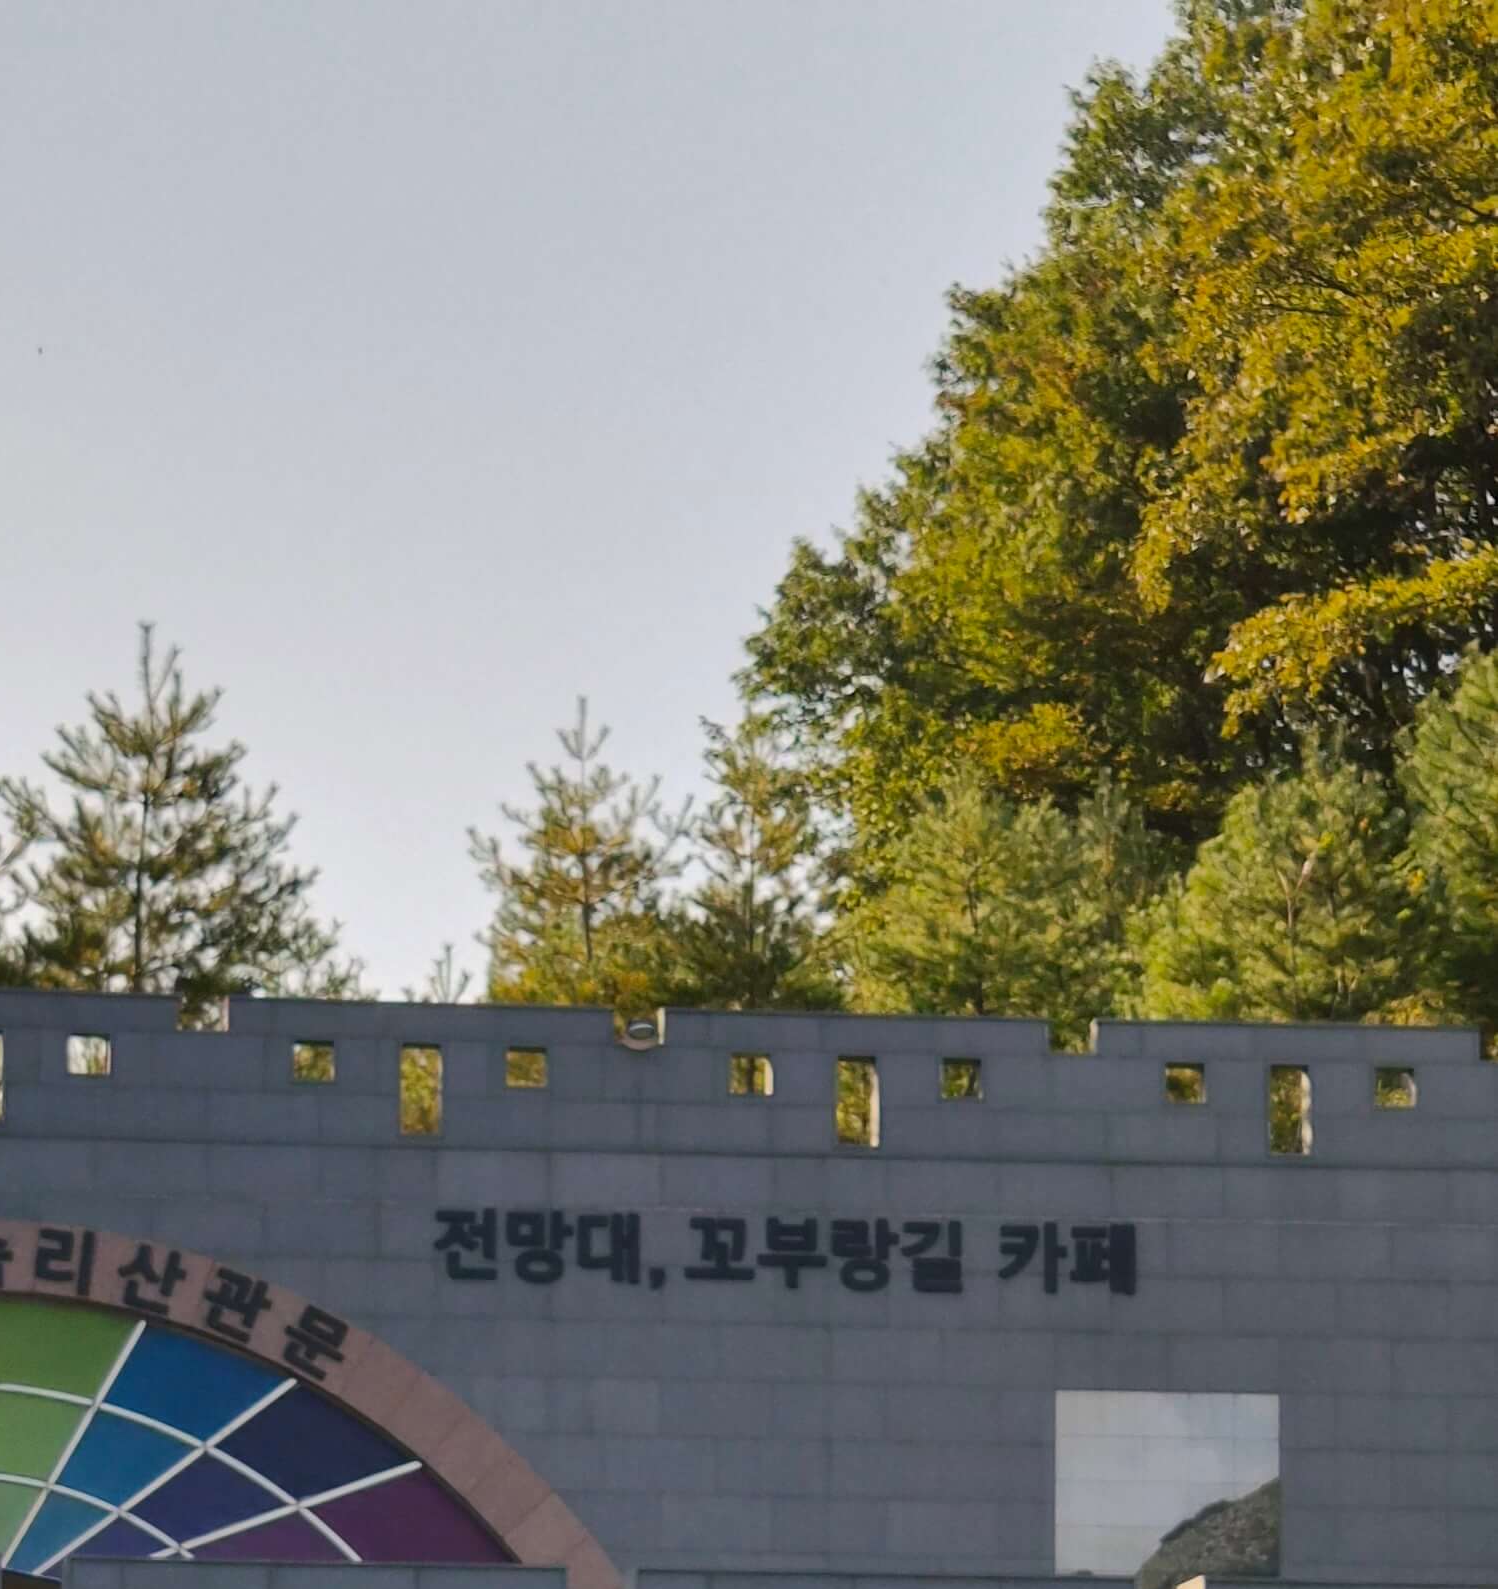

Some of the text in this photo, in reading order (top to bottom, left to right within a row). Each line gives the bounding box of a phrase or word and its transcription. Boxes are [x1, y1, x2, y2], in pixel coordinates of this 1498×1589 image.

[433, 1207, 1138, 1296] 전망대, 꼬부랑길 카페
